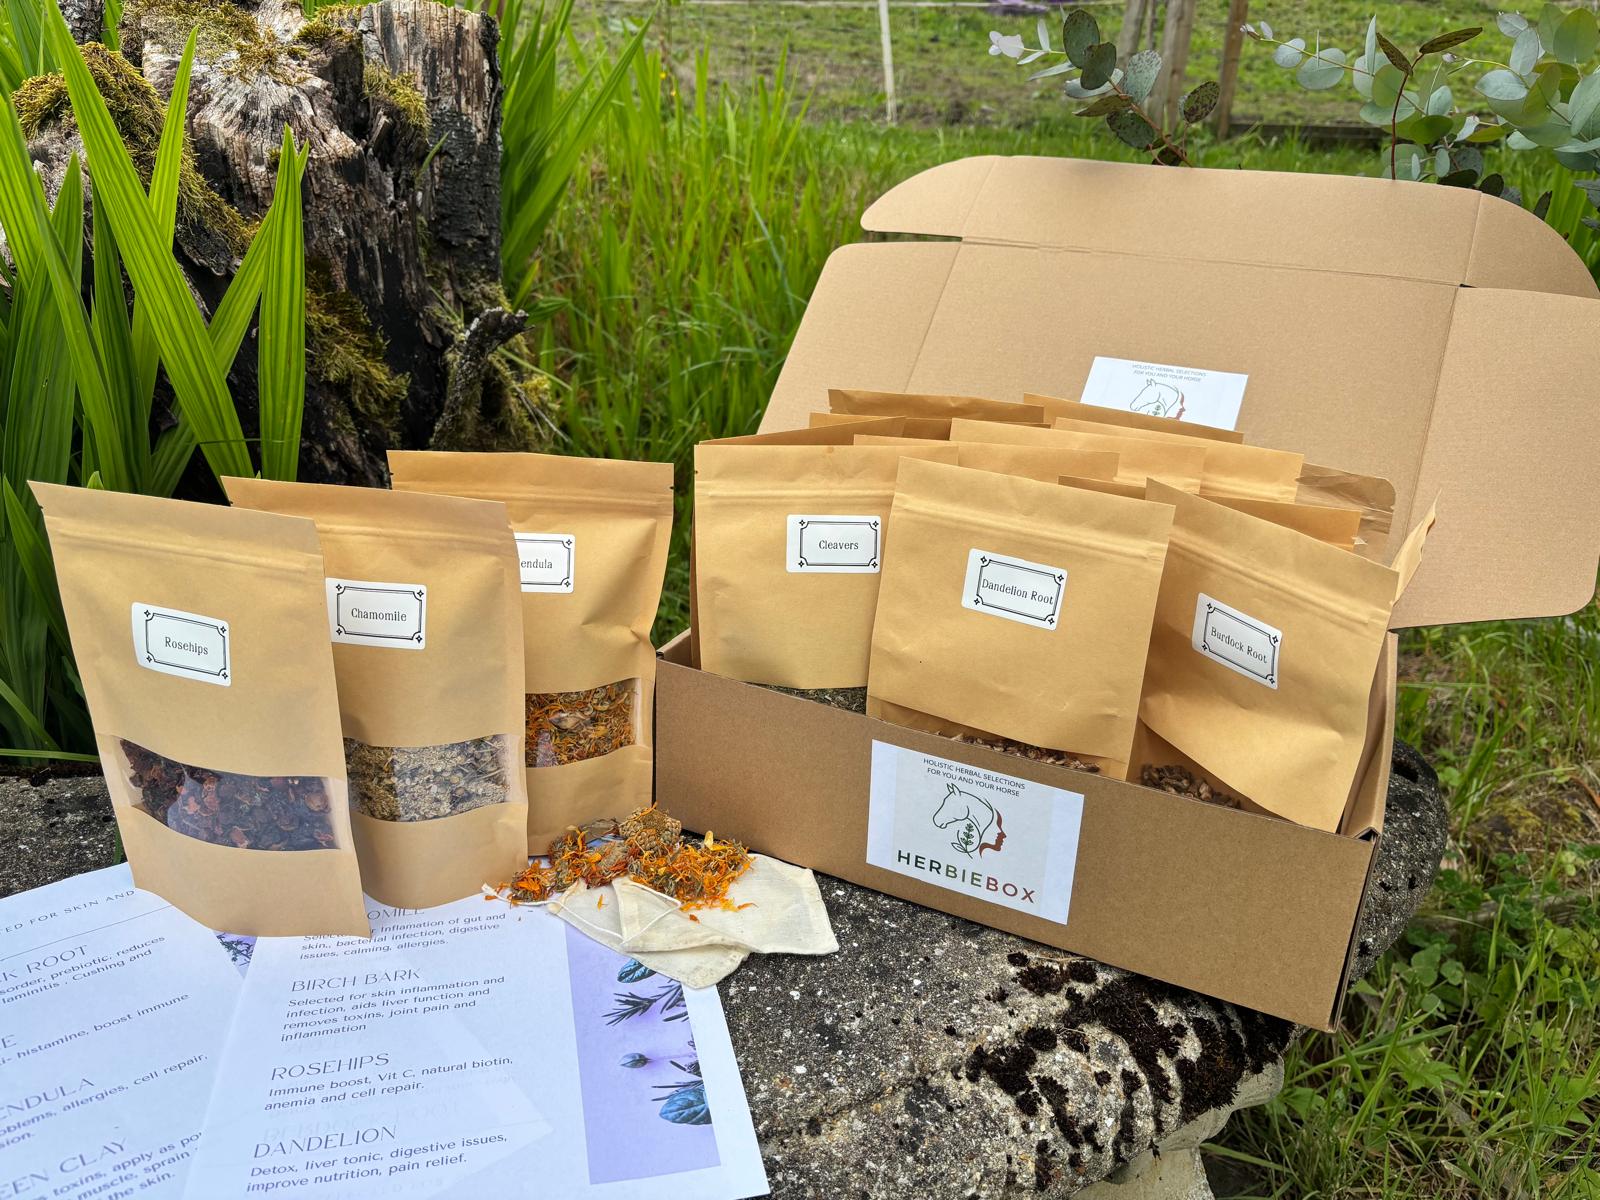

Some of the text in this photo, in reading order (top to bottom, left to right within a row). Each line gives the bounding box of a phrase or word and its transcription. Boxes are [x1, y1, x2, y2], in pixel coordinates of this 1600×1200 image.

[818, 539, 859, 550] Cleavers
[981, 578, 1054, 605] Dandelion Root
[351, 608, 407, 622] Chamomile
[164, 636, 209, 656] Rosehips
[1210, 626, 1268, 664] Burdock Root
[923, 758, 1026, 790] HOLISTIC HERBAL SELECTIONS
[927, 768, 1020, 798] FOR YOU AND YOUR HORSE
[897, 849, 1035, 904] HERBIEBOX
[29, 911, 59, 925] FOR
[64, 899, 100, 914] SKIN
[105, 889, 135, 903] AND
[380, 918, 444, 933] inflamation
[448, 916, 460, 925] of
[463, 914, 481, 926] gut
[486, 912, 506, 921] and
[391, 928, 445, 942] infection,
[448, 922, 500, 936] digestive
[26, 944, 87, 974] ROOT
[50, 953, 112, 981] prebiotic,
[116, 935, 166, 957] reduces
[300, 949, 339, 960] issues,
[343, 943, 392, 956] calming,
[2, 949, 152, 1004] laminitis Cushing and
[288, 975, 505, 1008] Selected for skin inflammation and
[291, 967, 421, 992] BIRCH BARK
[283, 999, 476, 1031] removes toxins, joint pain and
[286, 987, 490, 1019] infection, aids liver function and
[17, 1030, 89, 1059] histamine,
[93, 1012, 133, 1033] boost
[137, 992, 192, 1016] immune
[281, 1022, 367, 1043] inflammation
[269, 1056, 513, 1098] Immune boost, Vit C, natural biotin,
[271, 1052, 390, 1081] ROSEHIPS
[62, 1084, 129, 1112] allergies,
[133, 1070, 158, 1086] cell
[163, 1054, 208, 1076] repair,
[264, 1080, 425, 1111] anemia and cell repair.
[59, 1136, 127, 1174] CLAY
[250, 1133, 507, 1178] Detox, liver tonic, digestive issues,
[253, 1125, 397, 1159] DANDELION
[53, 1143, 176, 1198] toxins, apply as
[143, 1151, 190, 1173] sprain
[246, 1153, 467, 1193] improve nutrition, pain relief.
[139, 1172, 176, 1190] skin.
